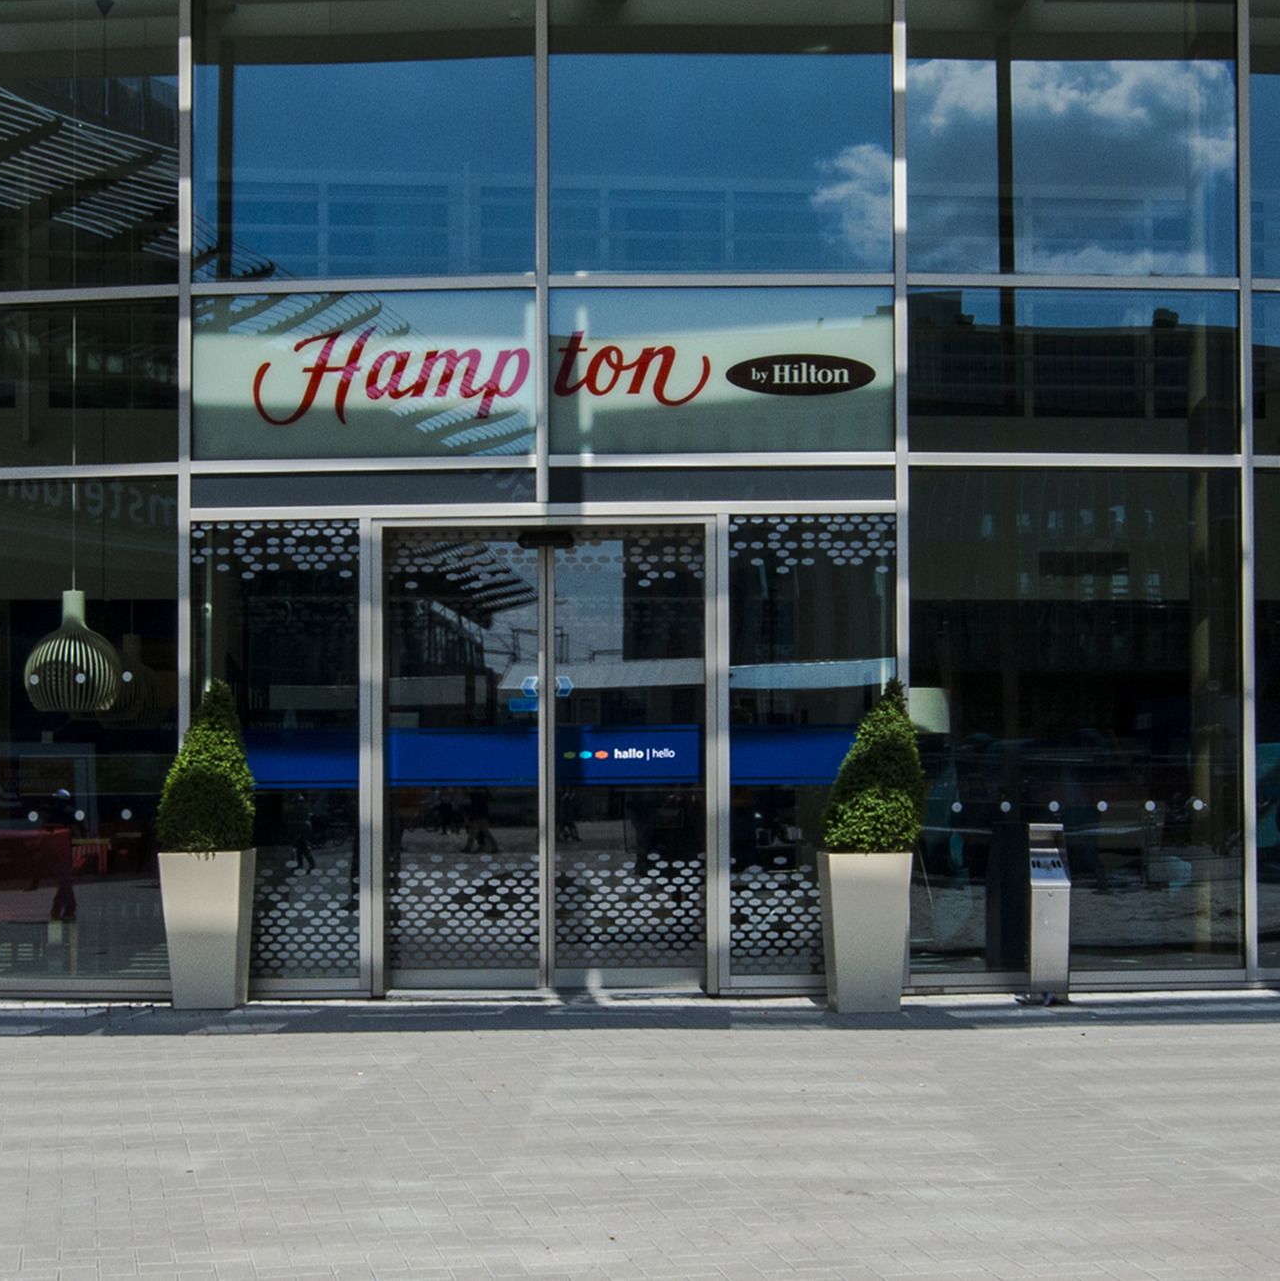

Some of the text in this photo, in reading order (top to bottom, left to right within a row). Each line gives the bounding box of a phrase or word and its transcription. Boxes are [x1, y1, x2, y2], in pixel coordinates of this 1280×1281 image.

[253, 325, 711, 426] Hampton
[751, 362, 850, 384] by Hilton
[614, 748, 675, 759] hallo hello
